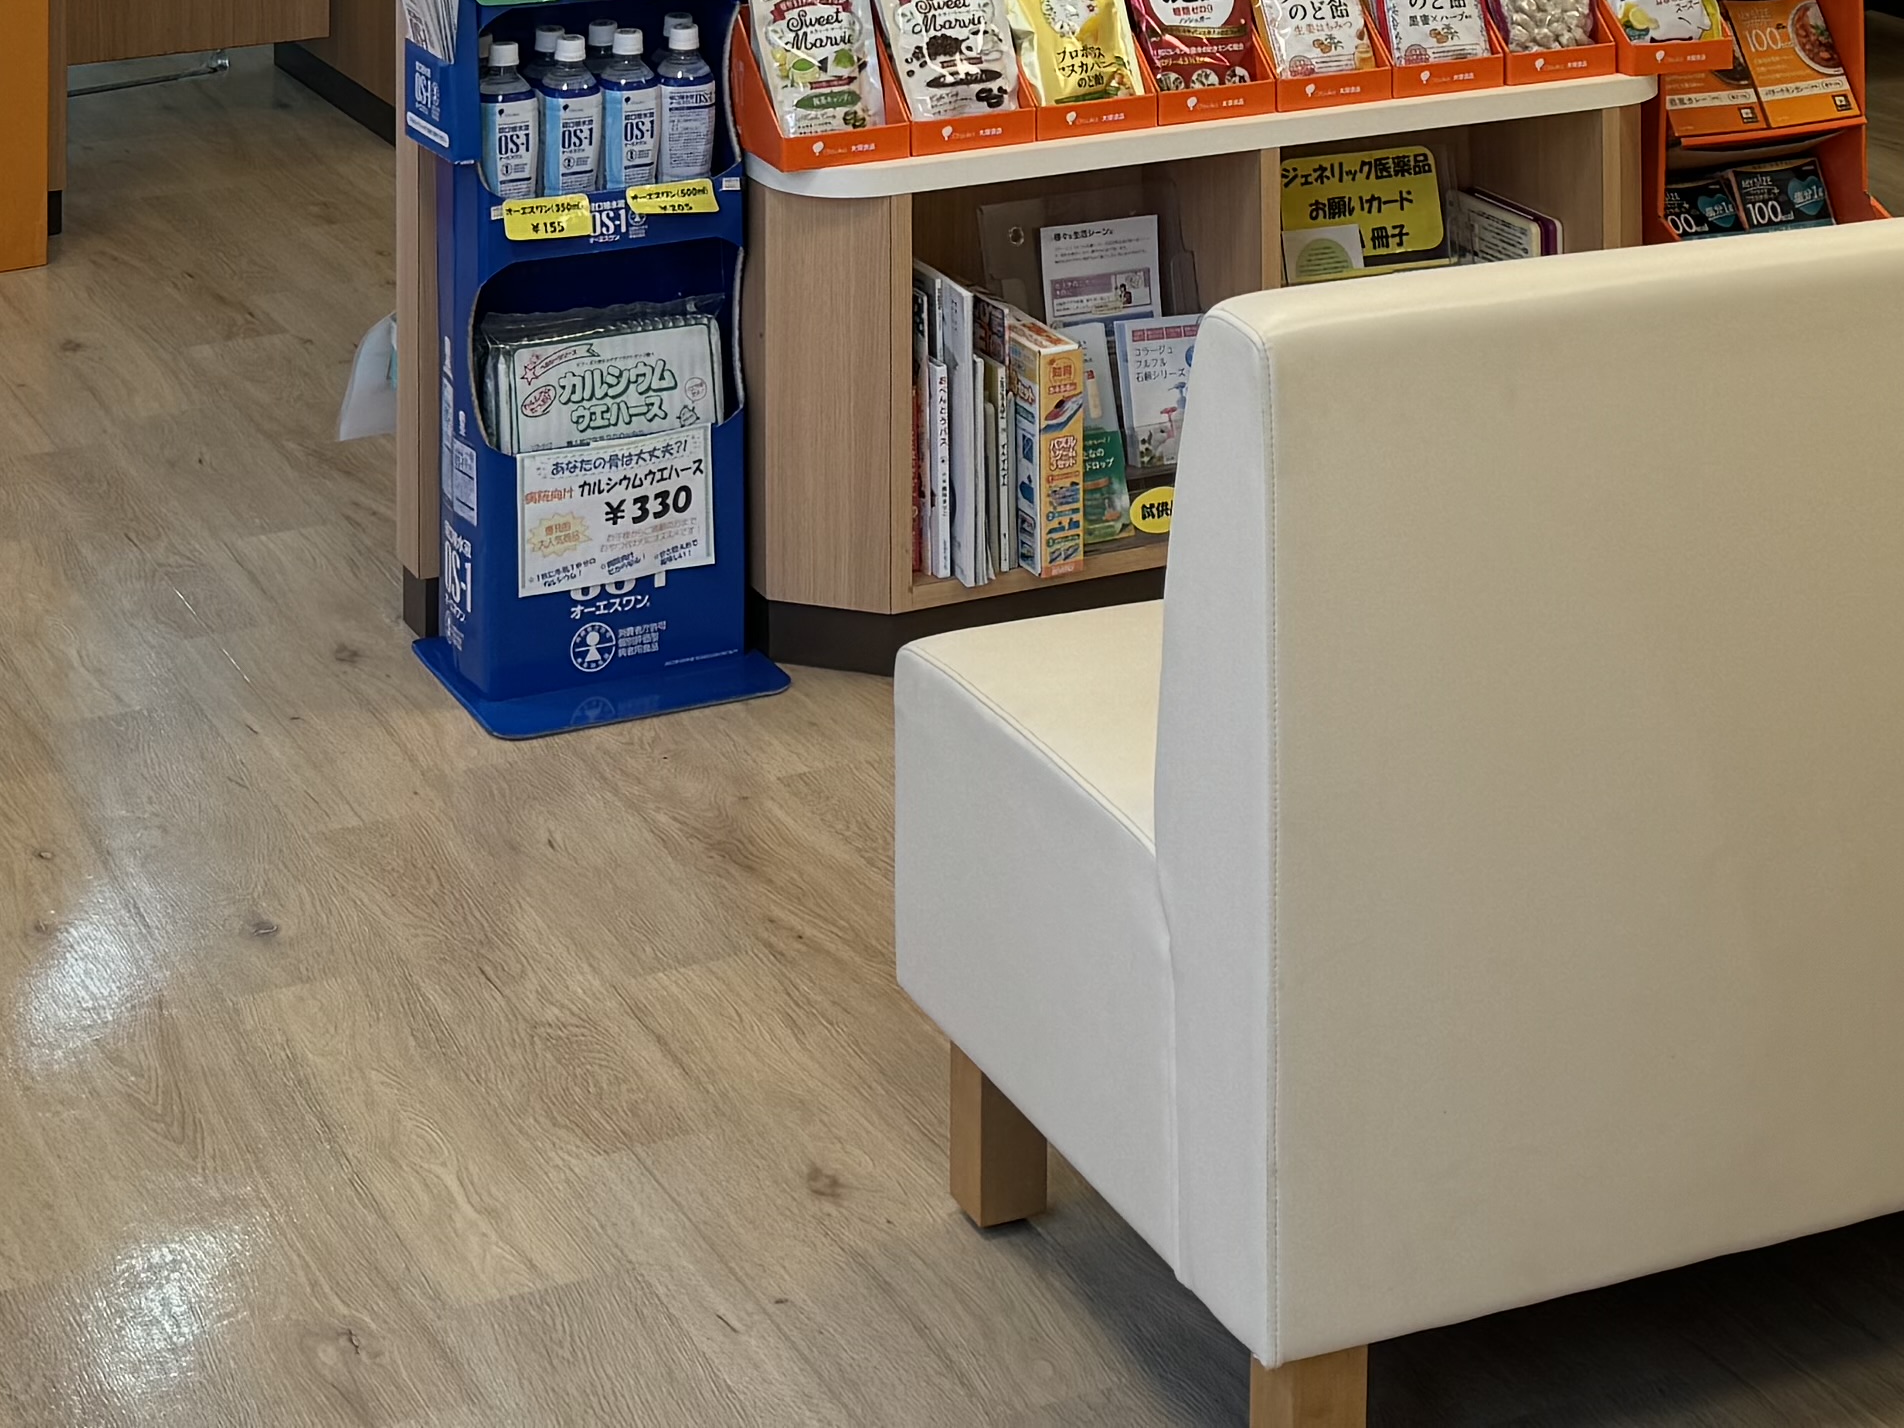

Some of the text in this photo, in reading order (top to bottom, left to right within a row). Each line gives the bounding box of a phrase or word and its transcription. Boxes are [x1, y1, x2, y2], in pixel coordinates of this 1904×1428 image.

[787, 8, 842, 32] Sweet
[1281, 153, 1433, 188] ジェネリック医薬品
[1308, 189, 1414, 220] お願いカード
[531, 219, 565, 234] ¥155
[1370, 224, 1409, 249] 冊子
[1135, 346, 1174, 357] コラージュ
[558, 359, 677, 404] カルシウム
[571, 396, 667, 432] ウエハース
[551, 439, 688, 476] あなたの骨は大丈夫?!
[578, 458, 704, 497] カルシウムウエハース
[605, 485, 692, 526] ¥330
[571, 595, 648, 619] オーエスワン
